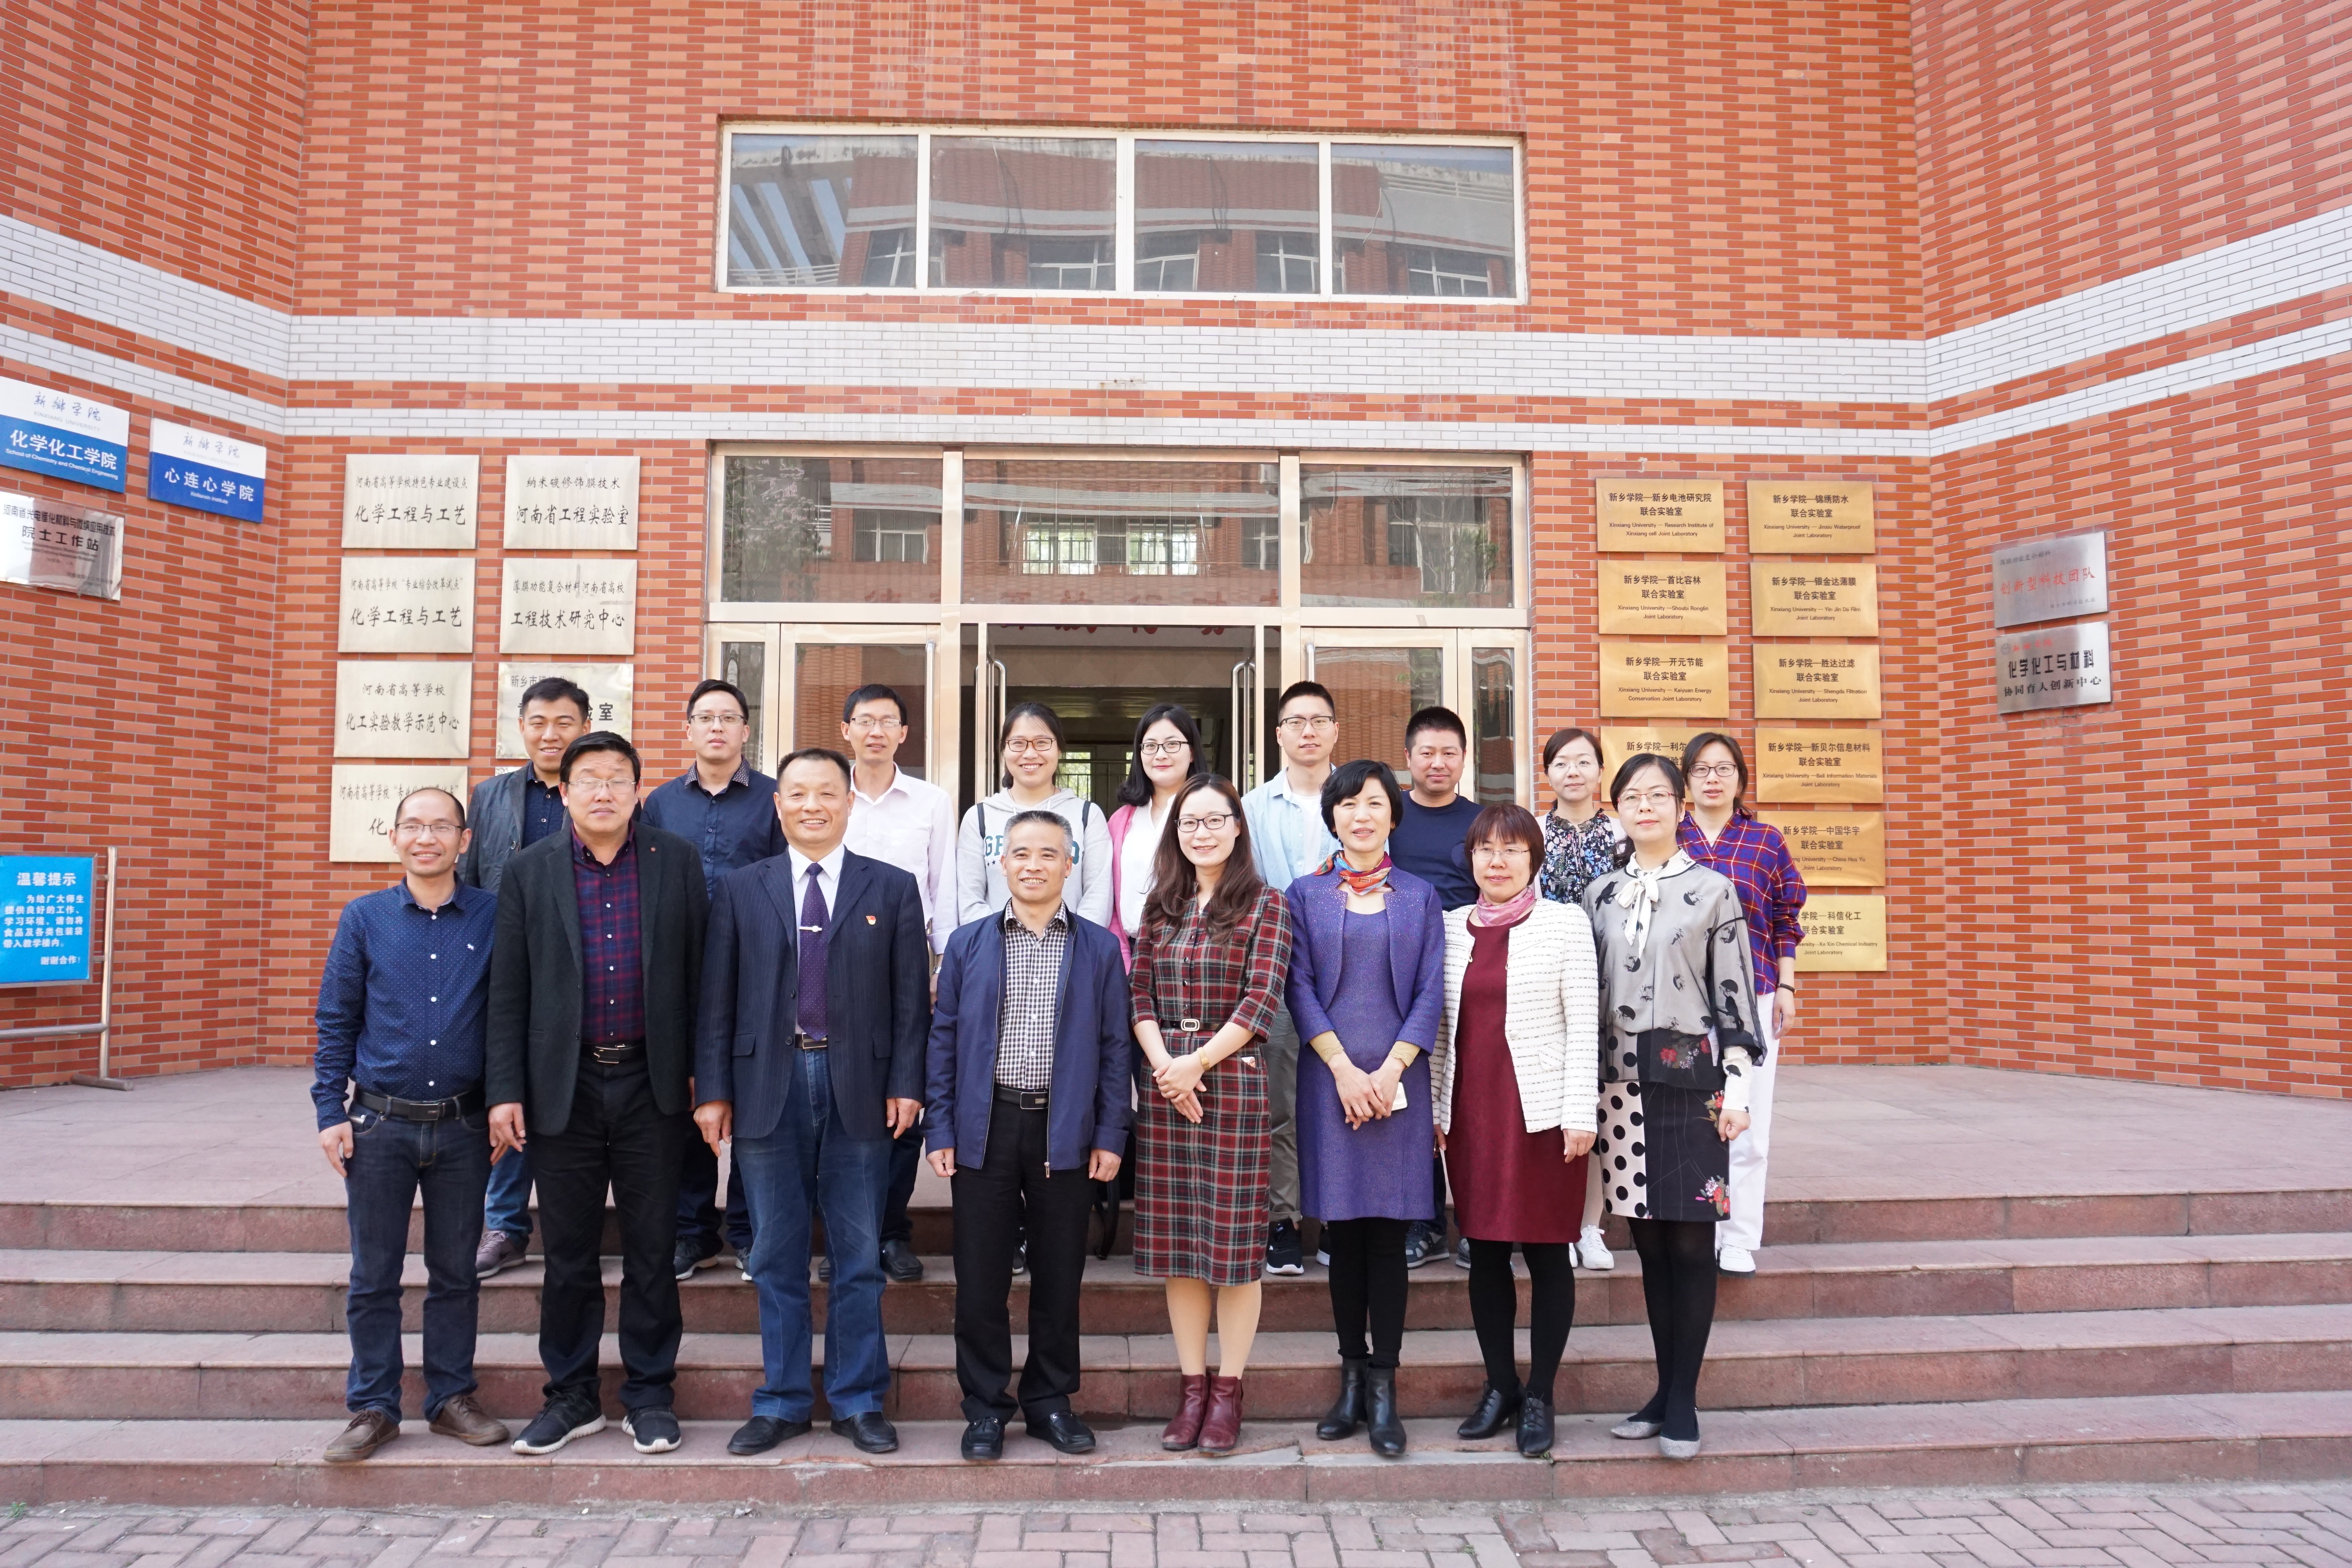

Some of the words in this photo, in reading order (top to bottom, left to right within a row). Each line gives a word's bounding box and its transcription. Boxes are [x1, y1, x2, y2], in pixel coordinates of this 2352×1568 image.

[33, 411, 63, 423] XINXIANG
[65, 419, 100, 431] UNIVERSITY
[10, 430, 117, 470] 化学化工学院
[32, 455, 57, 465] Chemistry
[69, 462, 91, 472] Chemical
[92, 468, 118, 480] Engineering
[165, 467, 254, 501] 心连心学院
[356, 475, 467, 489] 河南省高等学校特色专业建设点
[526, 476, 620, 489] 纳米碳修饰膜技术
[355, 503, 465, 525] 化学工程与工艺
[517, 504, 628, 525] 河南省工程实验室
[1640, 507, 1683, 516] 联合实验室
[1791, 509, 1833, 517] 联合实验室
[22, 525, 98, 551] 院士工作站
[513, 579, 625, 594] 薄膜功能复合材料河南省高校
[2001, 567, 2096, 594] 创新型科技团队
[1642, 590, 1685, 599] 联合实验室
[1794, 591, 1837, 600] 联合实验室
[350, 606, 462, 627] 化学工程与工艺
[511, 609, 625, 631] 工程技术研究中心
[2009, 649, 2094, 679] 化学化工与材料
[1643, 671, 1687, 681] 联合实验室
[1797, 673, 1839, 682] 联合实验室
[363, 682, 445, 697] 河南省高等学校
[2004, 677, 2101, 697] 协同育人创新中心
[346, 711, 459, 734] 化工实验教学示范中心
[1799, 757, 1841, 766] 联合实验室
[1801, 840, 1844, 849] 联合实验室
[17, 872, 76, 886] 温馨提示
[26, 895, 84, 904] 为给广大师生
[5, 905, 79, 915] 提供良好的工作、
[4, 927, 83, 937] 食品及各类包装袋
[1802, 926, 1845, 935] 联合实验室
[3, 938, 64, 948] 带入教学楼内。
